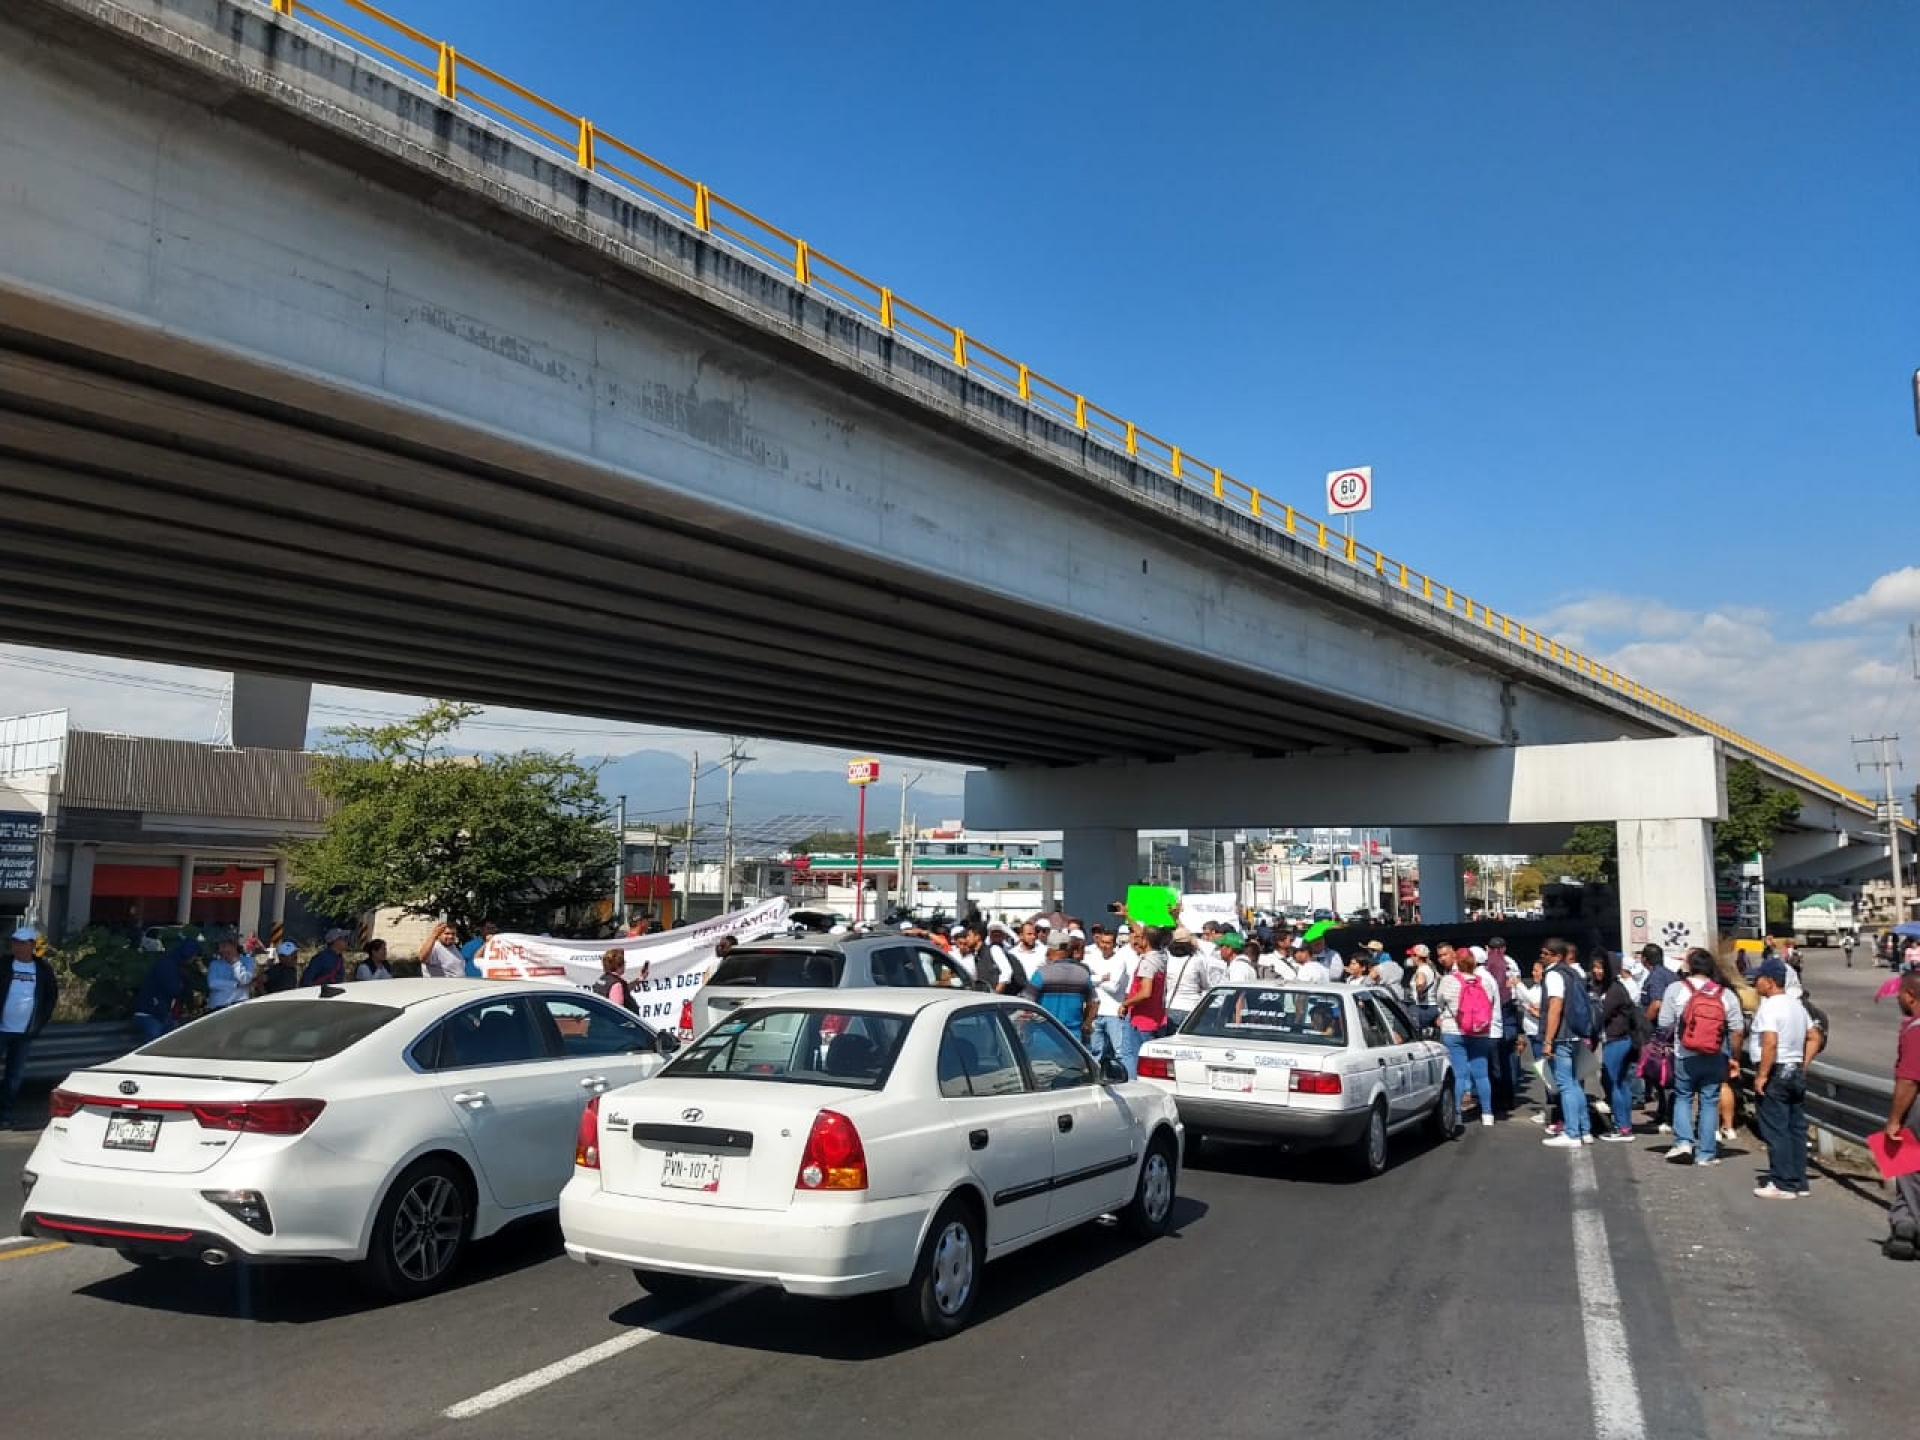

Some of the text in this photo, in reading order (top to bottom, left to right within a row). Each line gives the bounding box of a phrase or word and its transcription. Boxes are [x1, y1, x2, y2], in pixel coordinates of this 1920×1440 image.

[1341, 478, 1357, 494] 60
[654, 977, 672, 991] LA
[664, 1159, 720, 1181] PVN-107-C
